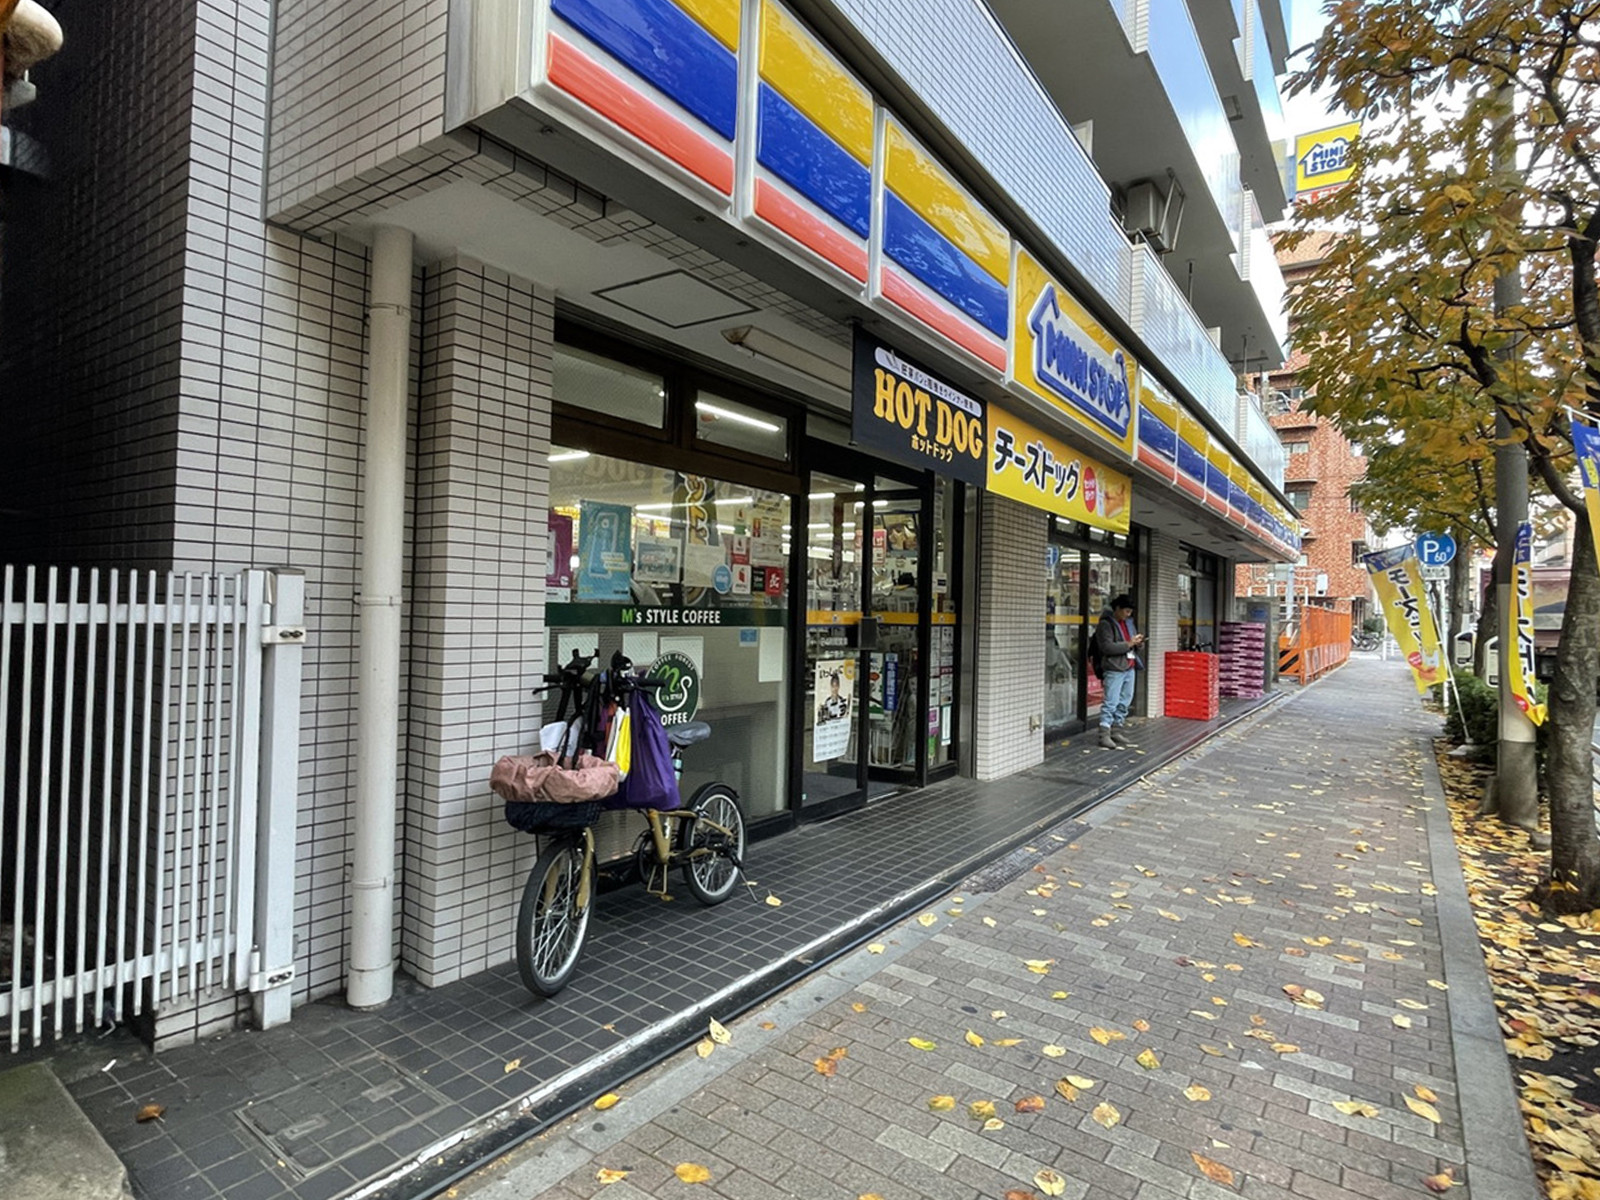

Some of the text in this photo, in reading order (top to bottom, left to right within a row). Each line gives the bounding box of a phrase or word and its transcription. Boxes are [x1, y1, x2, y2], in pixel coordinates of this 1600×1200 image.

[1312, 145, 1343, 161] MINI
[1047, 320, 1125, 419] MINI STOP
[874, 368, 983, 459] HOT DOG
[994, 429, 1080, 500] チーズドッグ
[1423, 540, 1440, 562] P
[622, 608, 720, 623] M's STYLE COFFEE
[661, 712, 688, 726] OFFEE
